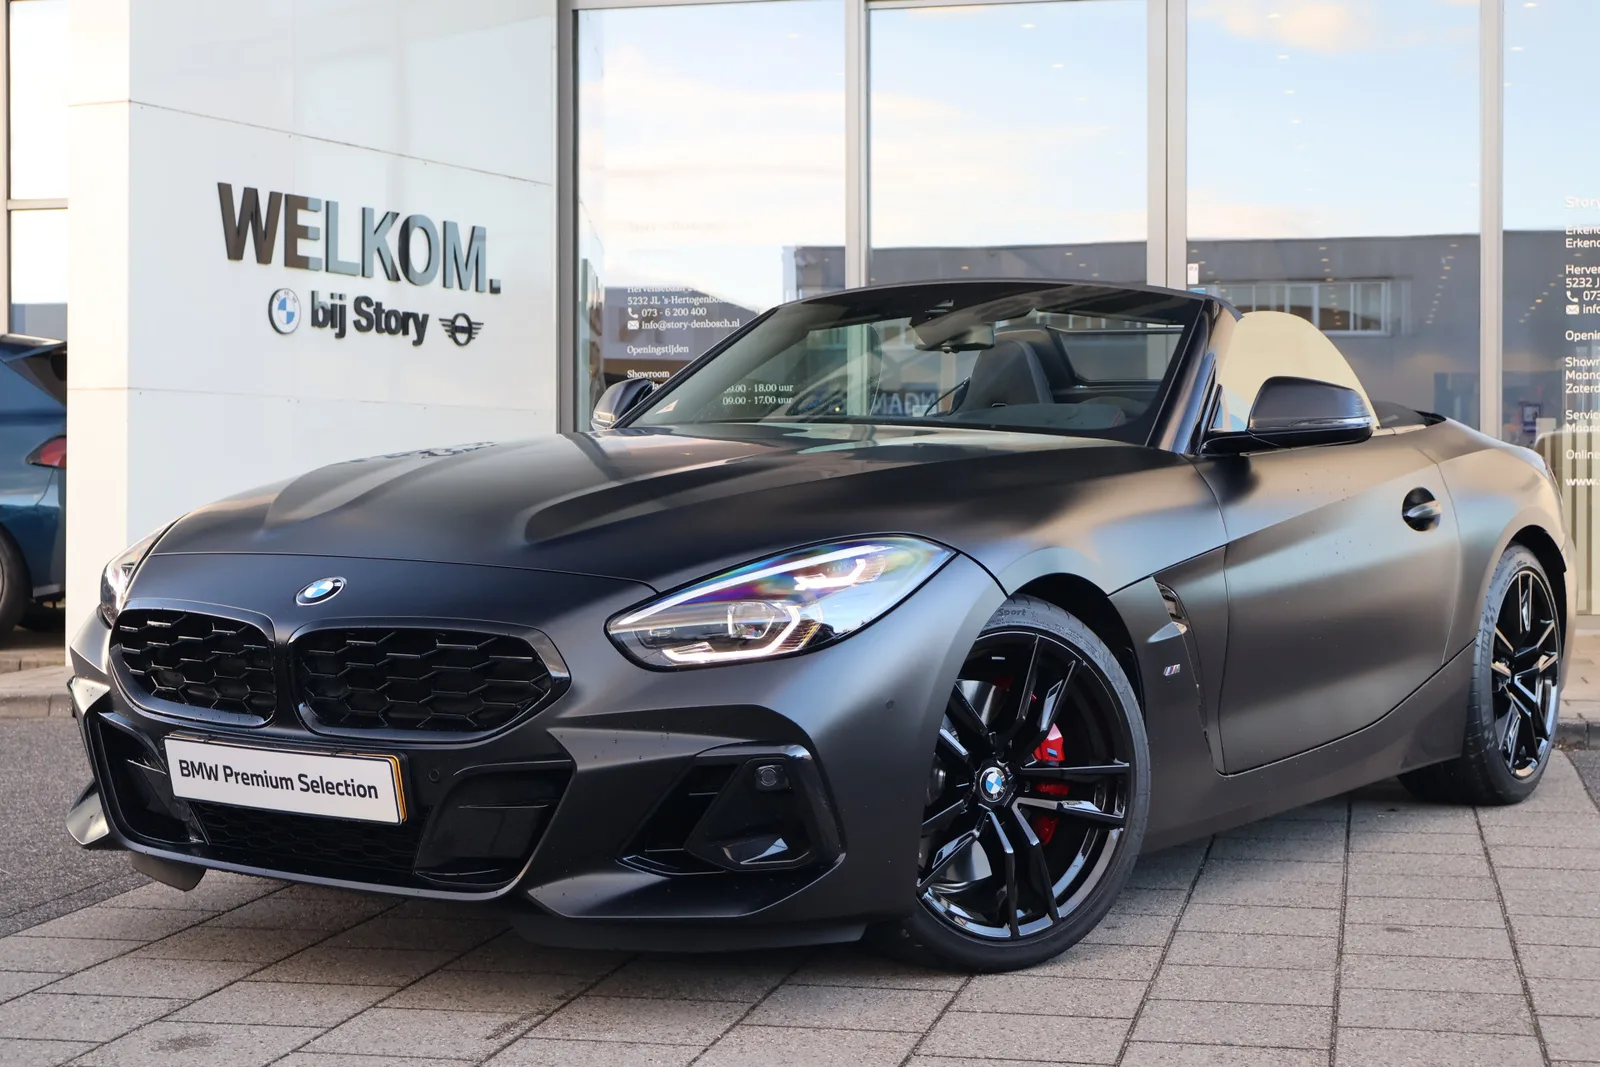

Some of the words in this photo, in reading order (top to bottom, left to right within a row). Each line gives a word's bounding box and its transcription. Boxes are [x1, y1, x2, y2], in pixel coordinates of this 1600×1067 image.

[217, 182, 502, 294] WELKOM.
[1565, 277, 1593, 288] 5232
[627, 296, 649, 306] 5232
[649, 296, 661, 305] JL
[641, 307, 658, 317] 073
[664, 308, 671, 316] 6
[672, 307, 689, 316] 200
[690, 307, 707, 316] 400
[310, 290, 347, 339] bij
[353, 295, 430, 347] Story
[641, 319, 740, 331] info@story-denbosch.nl
[626, 344, 689, 356] Openingstijden
[626, 369, 670, 379] Showroom
[754, 383, 778, 393] 18.00
[778, 384, 794, 392] uur
[722, 396, 747, 405] 09.00
[754, 396, 777, 405] 17.00
[777, 396, 793, 405] uur
[1565, 410, 1600, 420] Servic
[179, 759, 219, 782] BMW
[222, 764, 295, 792] Premium
[297, 773, 379, 799] Selection
